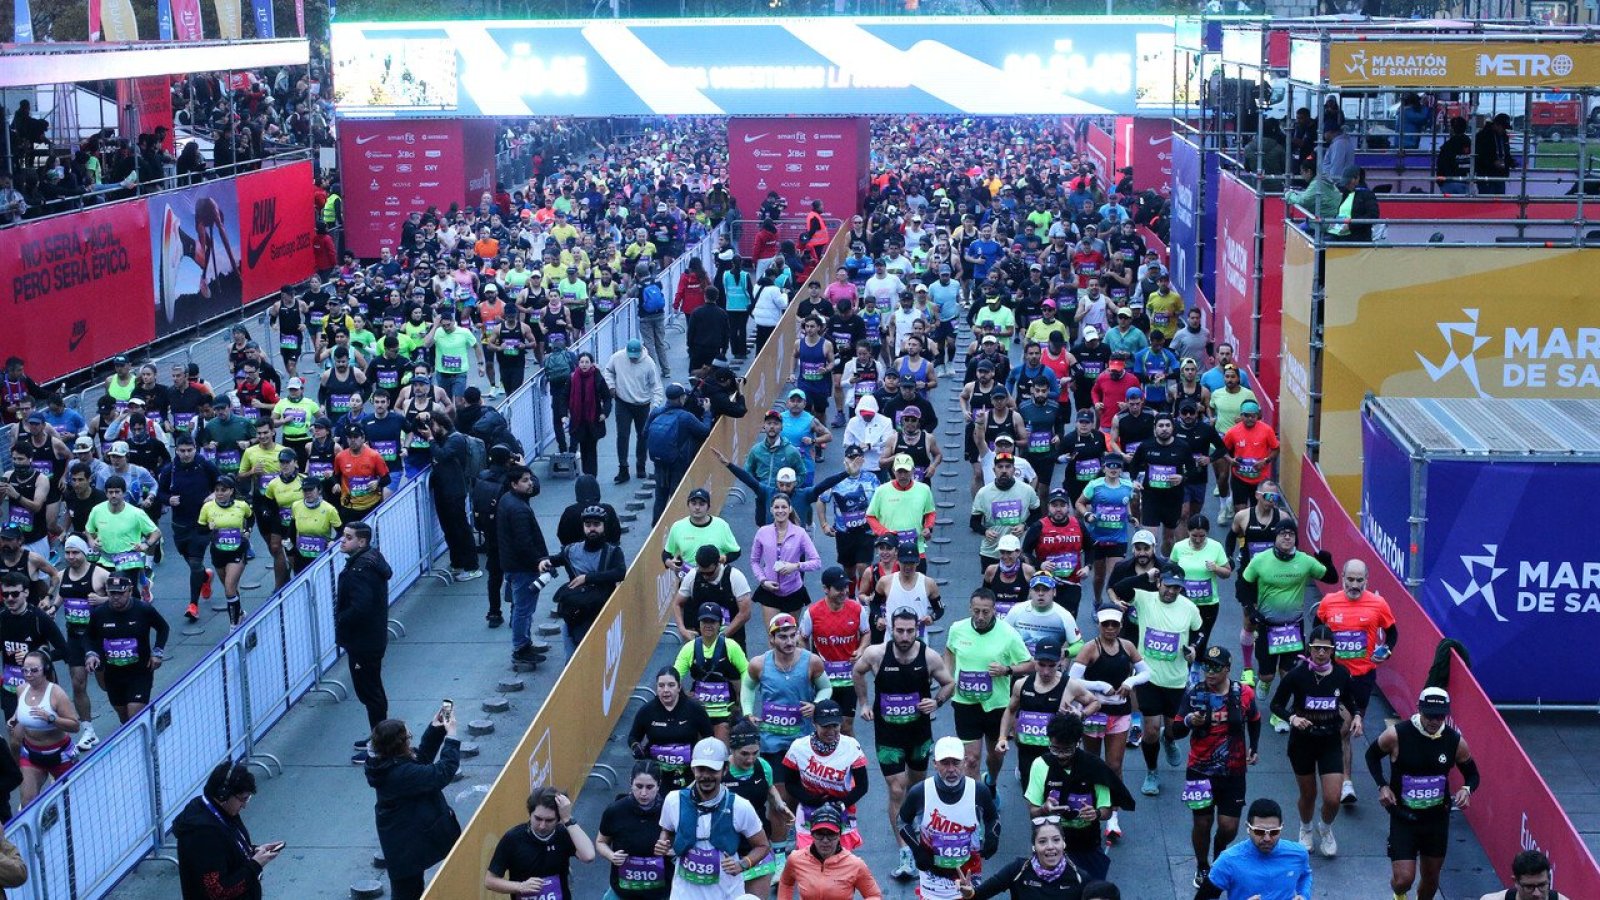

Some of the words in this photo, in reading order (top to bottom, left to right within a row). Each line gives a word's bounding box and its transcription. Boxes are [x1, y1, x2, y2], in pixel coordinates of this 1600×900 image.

[1372, 54, 1446, 66] MARATÓN
[1372, 67, 1387, 76] DE
[1389, 67, 1447, 76] SANTIAGO
[253, 196, 276, 235] RUN
[22, 241, 41, 270] NO
[45, 225, 81, 261] SERÁ
[271, 240, 296, 260] Santiago
[13, 271, 51, 303] PERO
[54, 256, 90, 290] SERÁ
[92, 247, 131, 280] ÉPICO.
[1505, 328, 1600, 359] MAR
[1503, 364, 1547, 388] DE
[1557, 364, 1600, 388] SA
[1519, 561, 1600, 589] MAR
[1517, 592, 1558, 613] DE
[1564, 592, 1600, 613] SA
[1273, 634, 1297, 645] 2744
[1148, 640, 1174, 652] 2074
[1335, 641, 1362, 651] 2796
[106, 650, 133, 660] 2993
[886, 705, 916, 716] 2928
[1306, 699, 1336, 710] 4784
[764, 713, 797, 726] 2800
[1022, 724, 1048, 736] 1204
[1407, 788, 1440, 799] 4589
[938, 846, 969, 857] 1426
[625, 868, 657, 881] 3810
